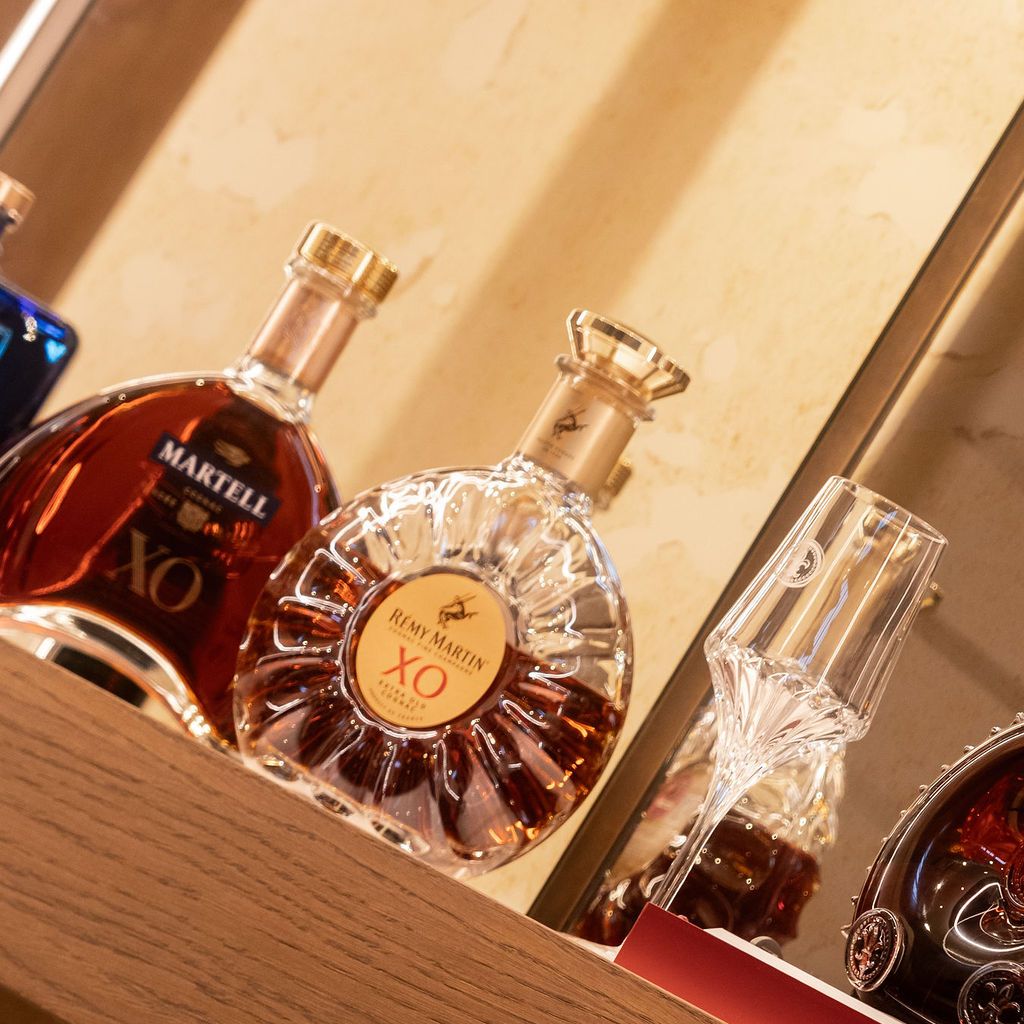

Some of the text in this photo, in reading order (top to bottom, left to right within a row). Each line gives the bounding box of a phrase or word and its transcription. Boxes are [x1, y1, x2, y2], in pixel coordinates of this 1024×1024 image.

[157, 440, 269, 520] MARTELL
[104, 527, 203, 613] XO
[381, 645, 448, 699] XO
[389, 607, 486, 672] RÉMY MARTIN
